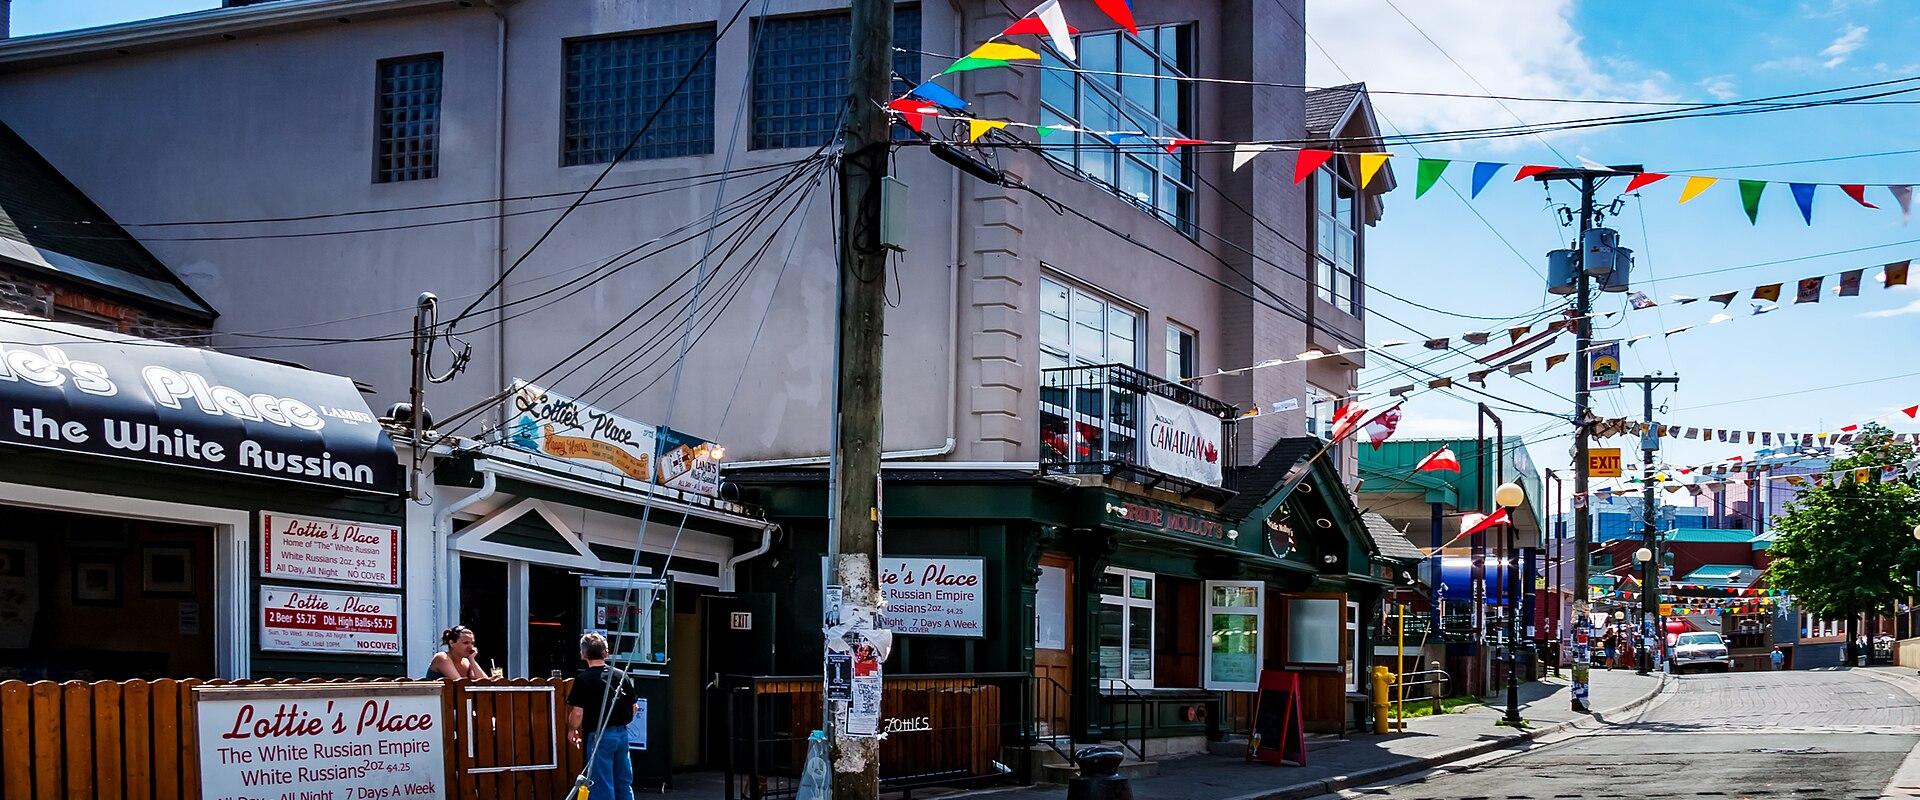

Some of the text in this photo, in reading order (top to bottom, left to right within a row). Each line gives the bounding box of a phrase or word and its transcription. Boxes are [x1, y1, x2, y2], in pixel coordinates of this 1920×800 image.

[142, 365, 325, 431] Place
[515, 394, 640, 449] Lottie's Place
[13, 407, 374, 485] the White Russian
[1150, 423, 1205, 461] CANADIAN
[1590, 455, 1620, 470] EXIT
[283, 520, 380, 545] Lottie's Place
[283, 539, 304, 549] Home
[305, 540, 313, 548] of
[335, 543, 354, 553] White
[355, 545, 380, 555] Russian
[281, 550, 304, 561] White
[305, 553, 338, 565] Russians
[356, 559, 376, 568] $4.25
[276, 563, 386, 582] All Day, All Night NO COVER
[881, 563, 978, 587] ie's Place
[284, 592, 381, 614] Lottie Place
[890, 589, 932, 600] Russian
[935, 590, 975, 603] Empire
[887, 603, 927, 613] ussians
[270, 611, 276, 623] 2
[276, 613, 293, 624] Beer
[296, 612, 317, 625] $5.75
[323, 615, 337, 627] Dbl.
[338, 616, 354, 630] High
[373, 617, 394, 629] $5.75
[733, 614, 750, 628] EXIT
[912, 618, 918, 627] 7
[920, 618, 942, 629] Days
[944, 620, 952, 628] A
[953, 620, 978, 629] Week
[357, 640, 398, 651] NO COVER
[222, 699, 433, 740] Lottie's Place
[217, 737, 431, 765] The White Russian Empire
[241, 769, 292, 787] White
[299, 764, 366, 783] Russians
[363, 759, 384, 771] 2oz
[281, 791, 302, 800] All
[300, 789, 333, 800] Night
[346, 787, 354, 799] 7
[359, 785, 389, 800] Days
[392, 784, 401, 796] A
[404, 782, 436, 796] Week
